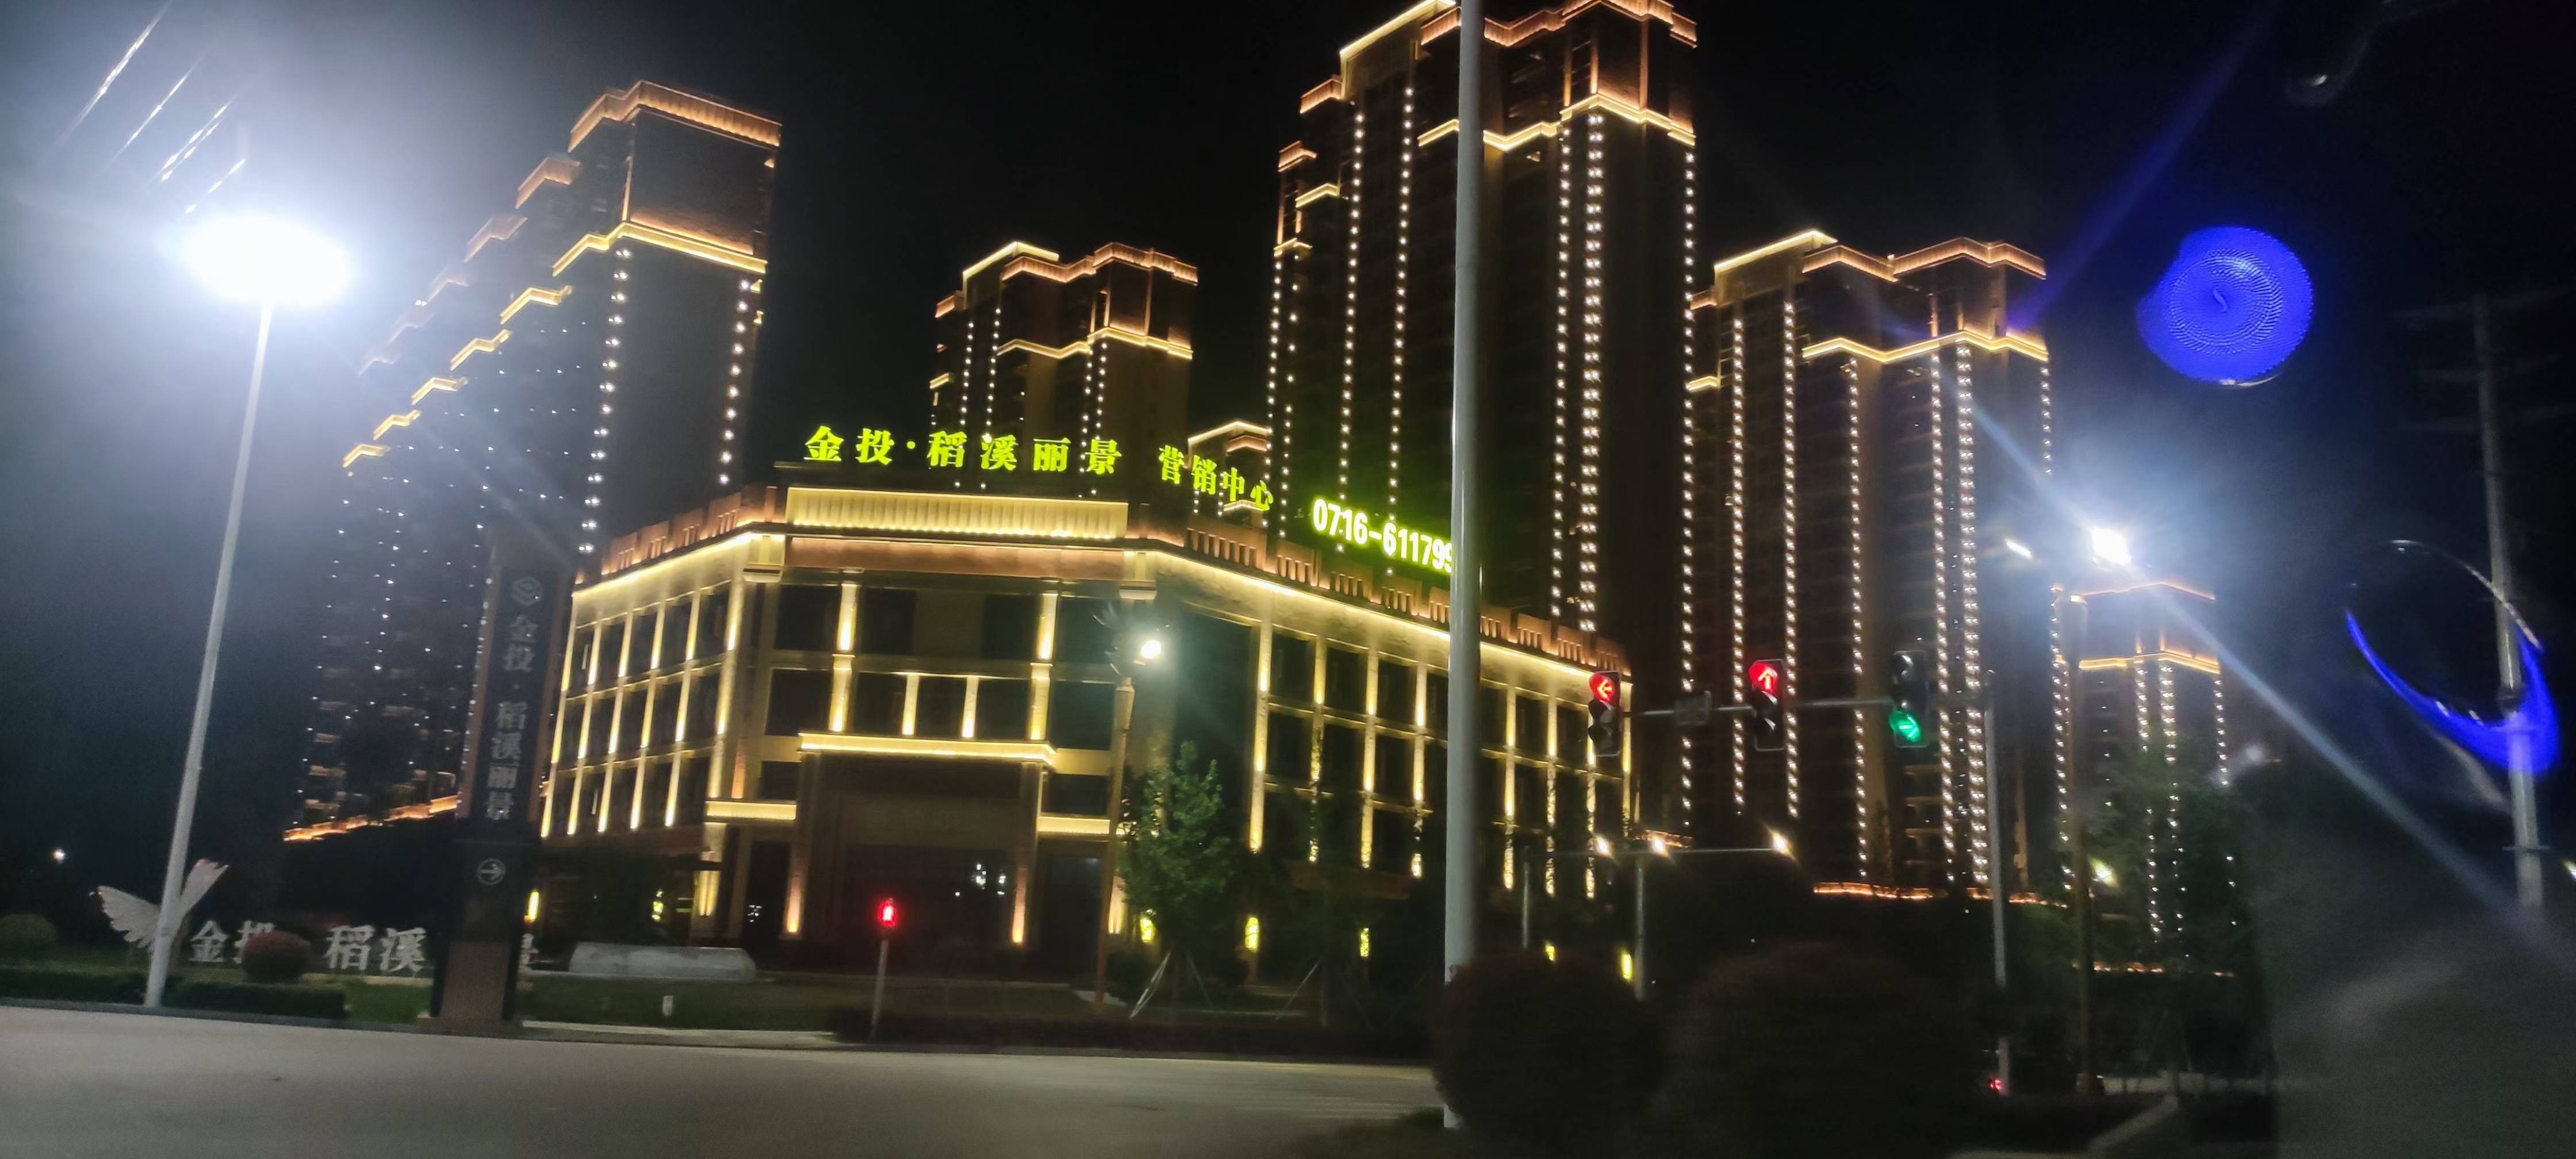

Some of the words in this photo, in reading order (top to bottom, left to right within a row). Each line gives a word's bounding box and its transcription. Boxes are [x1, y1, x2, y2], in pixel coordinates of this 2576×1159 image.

[804, 425, 1122, 476] 金投·稻溪丽景
[1158, 444, 1274, 512] 营销中心
